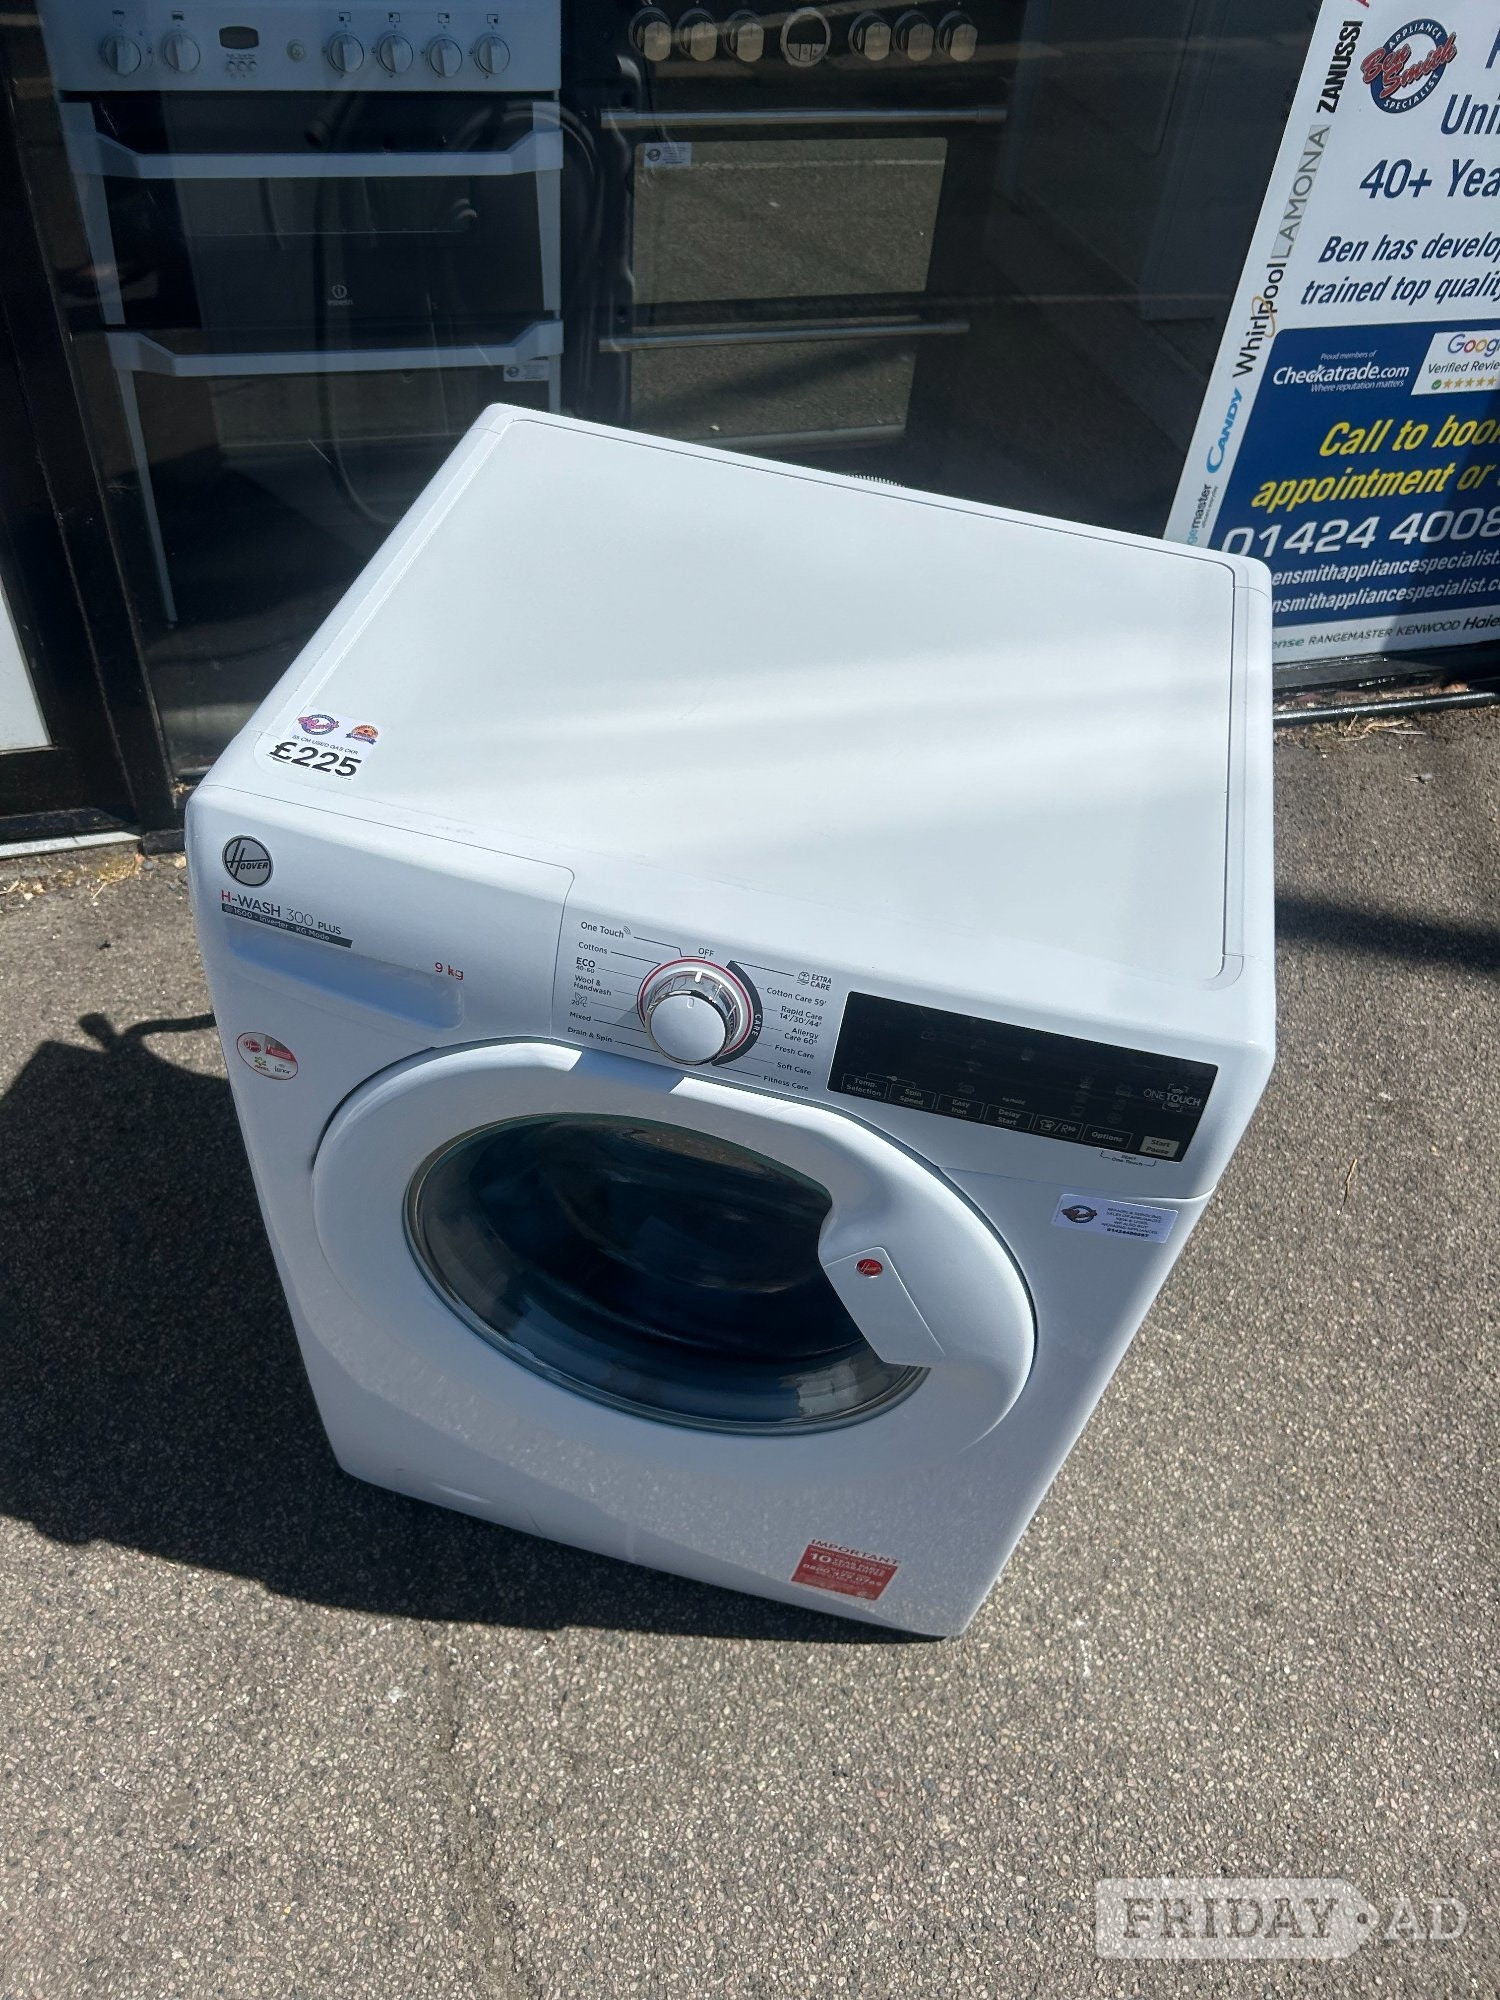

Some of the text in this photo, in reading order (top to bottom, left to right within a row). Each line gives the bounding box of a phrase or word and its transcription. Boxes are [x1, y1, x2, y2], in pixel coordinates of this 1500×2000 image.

[1388, 22, 1443, 49] APPLIANCE
[1316, 21, 1363, 113] ZANUSSI
[1360, 43, 1412, 84] Ben
[1380, 32, 1457, 98] Smith
[1383, 74, 1439, 110] SPECIALIST
[1359, 158, 1500, 199] 40+ Yea
[1271, 126, 1331, 258] LAMONA
[1318, 235, 1368, 263] Ben
[1371, 234, 1418, 260] has
[1300, 275, 1392, 305] trained
[1391, 277, 1432, 306] top
[1232, 263, 1287, 378] Whirlpool
[1448, 334, 1500, 357] Goog
[1320, 350, 1378, 360] Proud members of
[1272, 362, 1410, 385] Checkatrade.com
[1428, 362, 1470, 374] Verified
[1311, 379, 1404, 393] Where reputation matters
[1206, 387, 1242, 473] CANDY
[1319, 419, 1394, 457] Call
[1392, 420, 1429, 451] to
[1251, 463, 1456, 513] appointment
[1457, 464, 1496, 490] or
[1221, 516, 1377, 558] 01424
[1308, 627, 1393, 645] RANGEMASTER
[1396, 619, 1460, 637] KENWOOD
[312, 739, 330, 748] USED
[269, 741, 362, 776] £225
[226, 839, 270, 878] HOOVER
[221, 889, 342, 935] H-WASH 300 PLUS
[308, 930, 330, 941] Mode
[580, 921, 624, 938] One Touch
[578, 942, 608, 954] Cottons
[698, 948, 715, 957] OFF
[576, 957, 596, 968] ECO
[434, 962, 464, 981] 9 kg
[811, 974, 832, 984] EXTRA
[575, 975, 594, 985] Wool
[810, 981, 831, 992] CARE
[573, 982, 612, 996] Handwash
[767, 987, 793, 999] Cotton
[794, 993, 812, 1003] Care
[569, 1011, 591, 1021] Mixed
[781, 1006, 823, 1021] Rapid Care
[751, 1014, 761, 1036] CARE
[568, 1027, 587, 1037] Drain
[596, 1034, 612, 1043] Spin
[784, 1033, 817, 1046] Care 60°
[792, 1028, 819, 1040] Allergy
[774, 1044, 815, 1060] Fresh Care
[777, 1062, 812, 1076] Soft Care
[763, 1075, 809, 1092] Fitness Care
[846, 1084, 882, 1097] Selection
[899, 1095, 924, 1106] Speed
[904, 1088, 922, 1098] Spin
[951, 1107, 967, 1115] Iron
[952, 1099, 971, 1109] Easy
[998, 1108, 1021, 1119] Delay
[998, 1116, 1017, 1126] Start
[1091, 1131, 1124, 1143] Options
[1151, 1139, 1171, 1148] Start
[1146, 1146, 1170, 1155] Pause
[810, 1552, 832, 1563] 10
[811, 1539, 901, 1565] IMPORTANT
